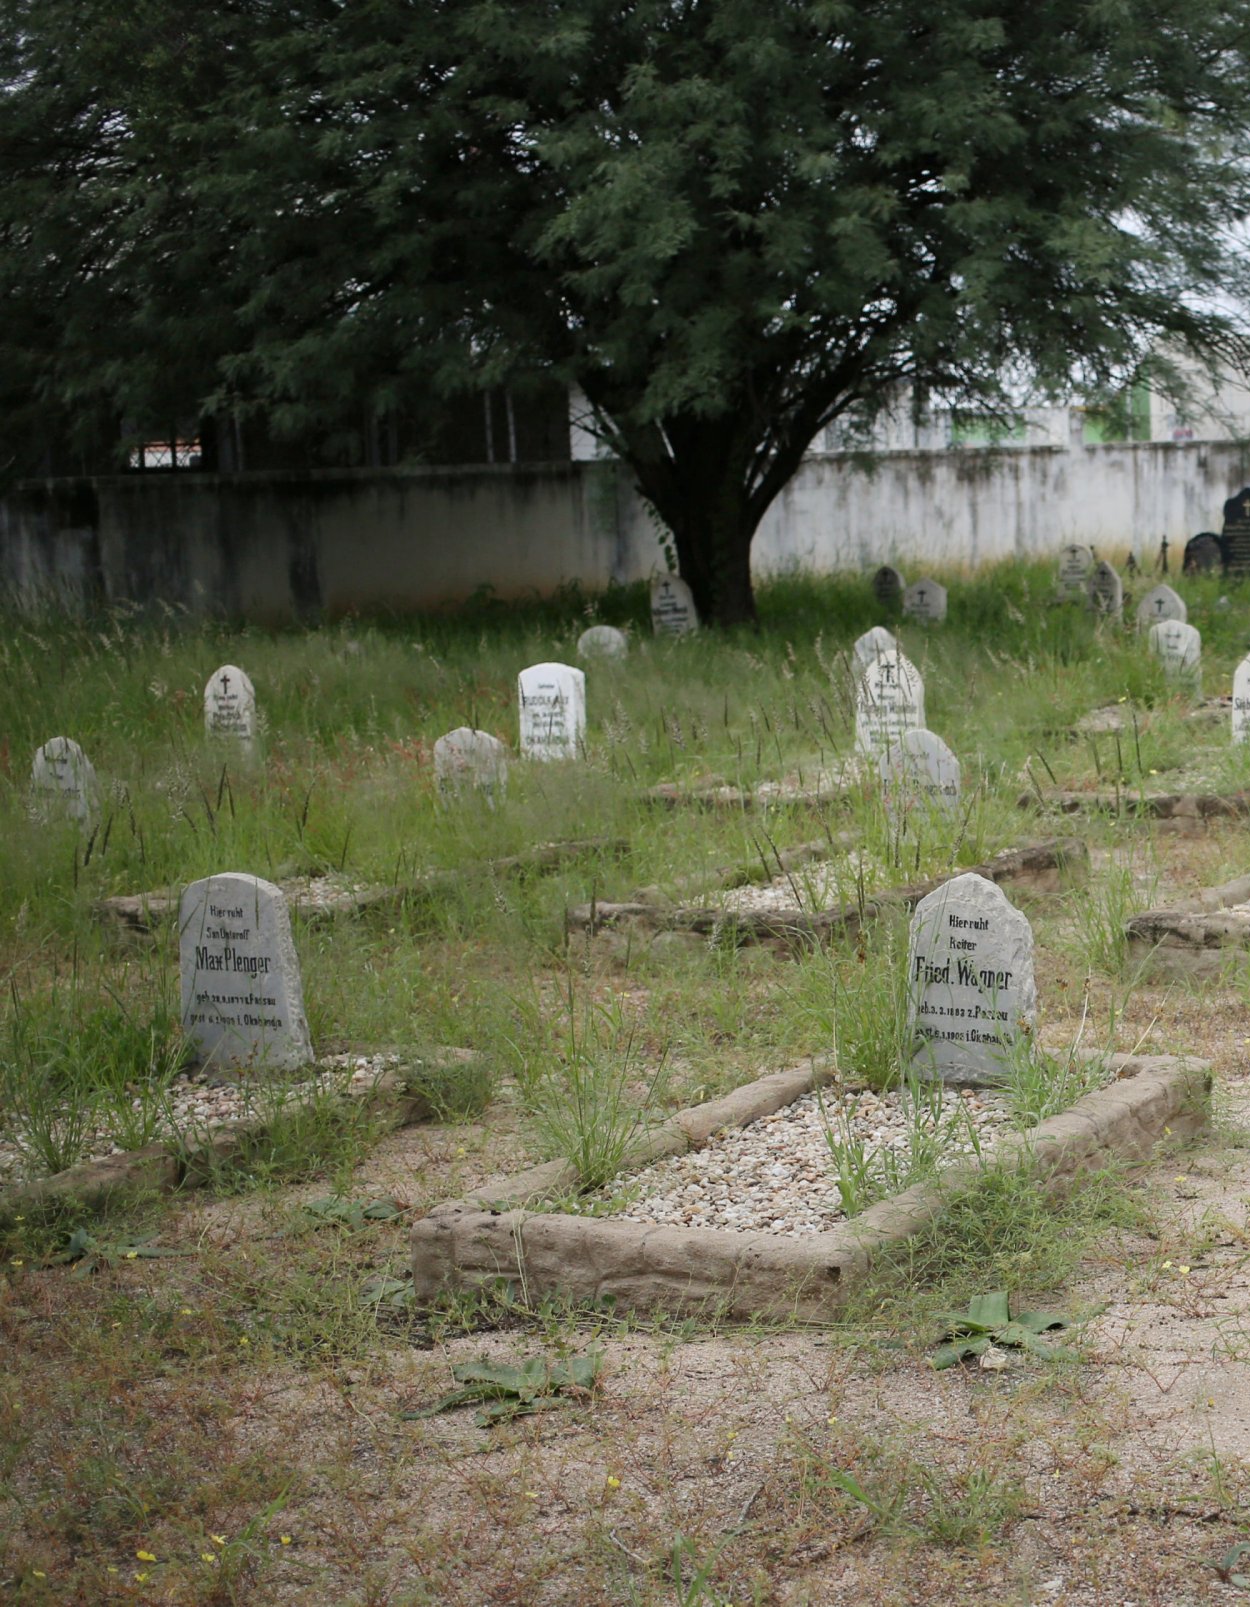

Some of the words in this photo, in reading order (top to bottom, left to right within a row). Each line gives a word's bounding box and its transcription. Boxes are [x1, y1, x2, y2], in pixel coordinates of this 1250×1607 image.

[210, 905, 226, 918] Hier
[226, 907, 244, 918] ruht
[949, 914, 969, 929] Hier
[969, 917, 989, 931] ruht
[949, 936, 977, 951] Reiter
[195, 946, 223, 972] Max
[224, 947, 272, 979] Plenger
[914, 955, 955, 985] Fried.
[957, 957, 1013, 994] Wagner
